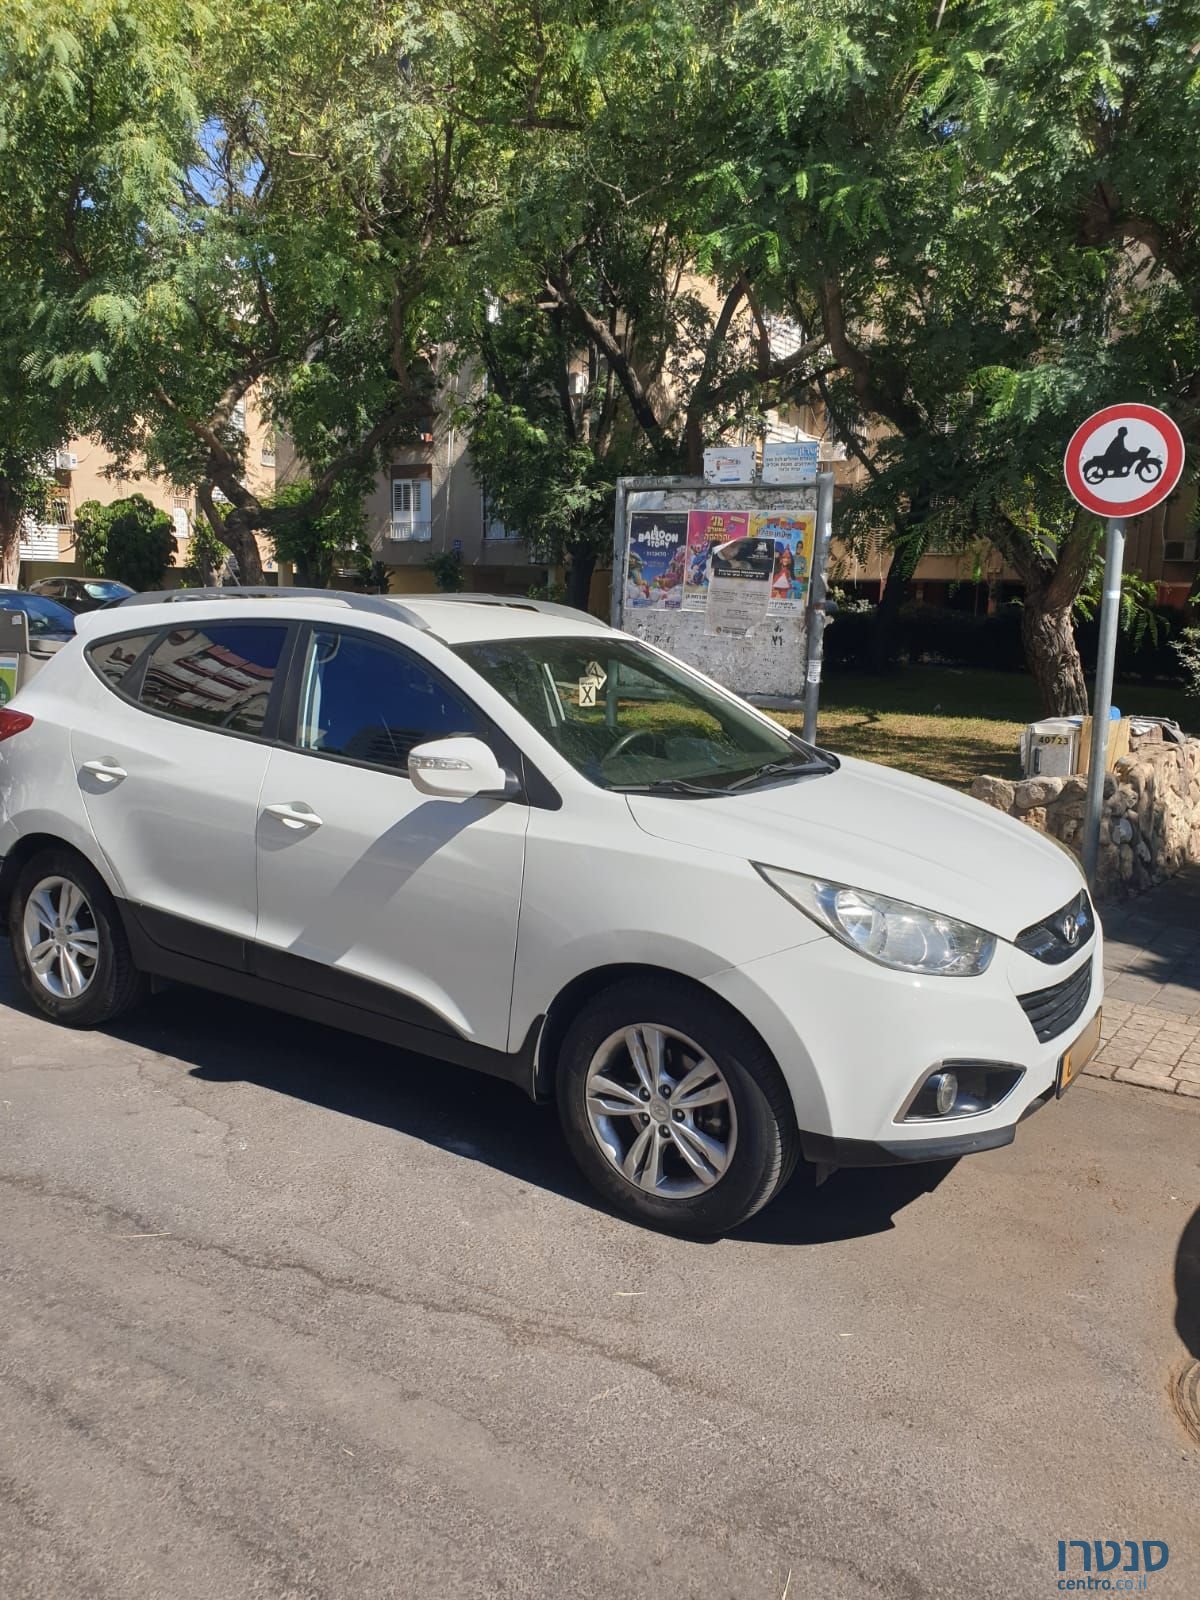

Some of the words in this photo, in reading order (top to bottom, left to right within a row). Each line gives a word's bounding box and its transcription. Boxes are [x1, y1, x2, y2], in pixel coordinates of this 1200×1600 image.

[638, 529, 679, 543] BALLOON
[647, 540, 670, 549] STORY
[582, 686, 593, 703] X
[1039, 736, 1069, 745] 40723
